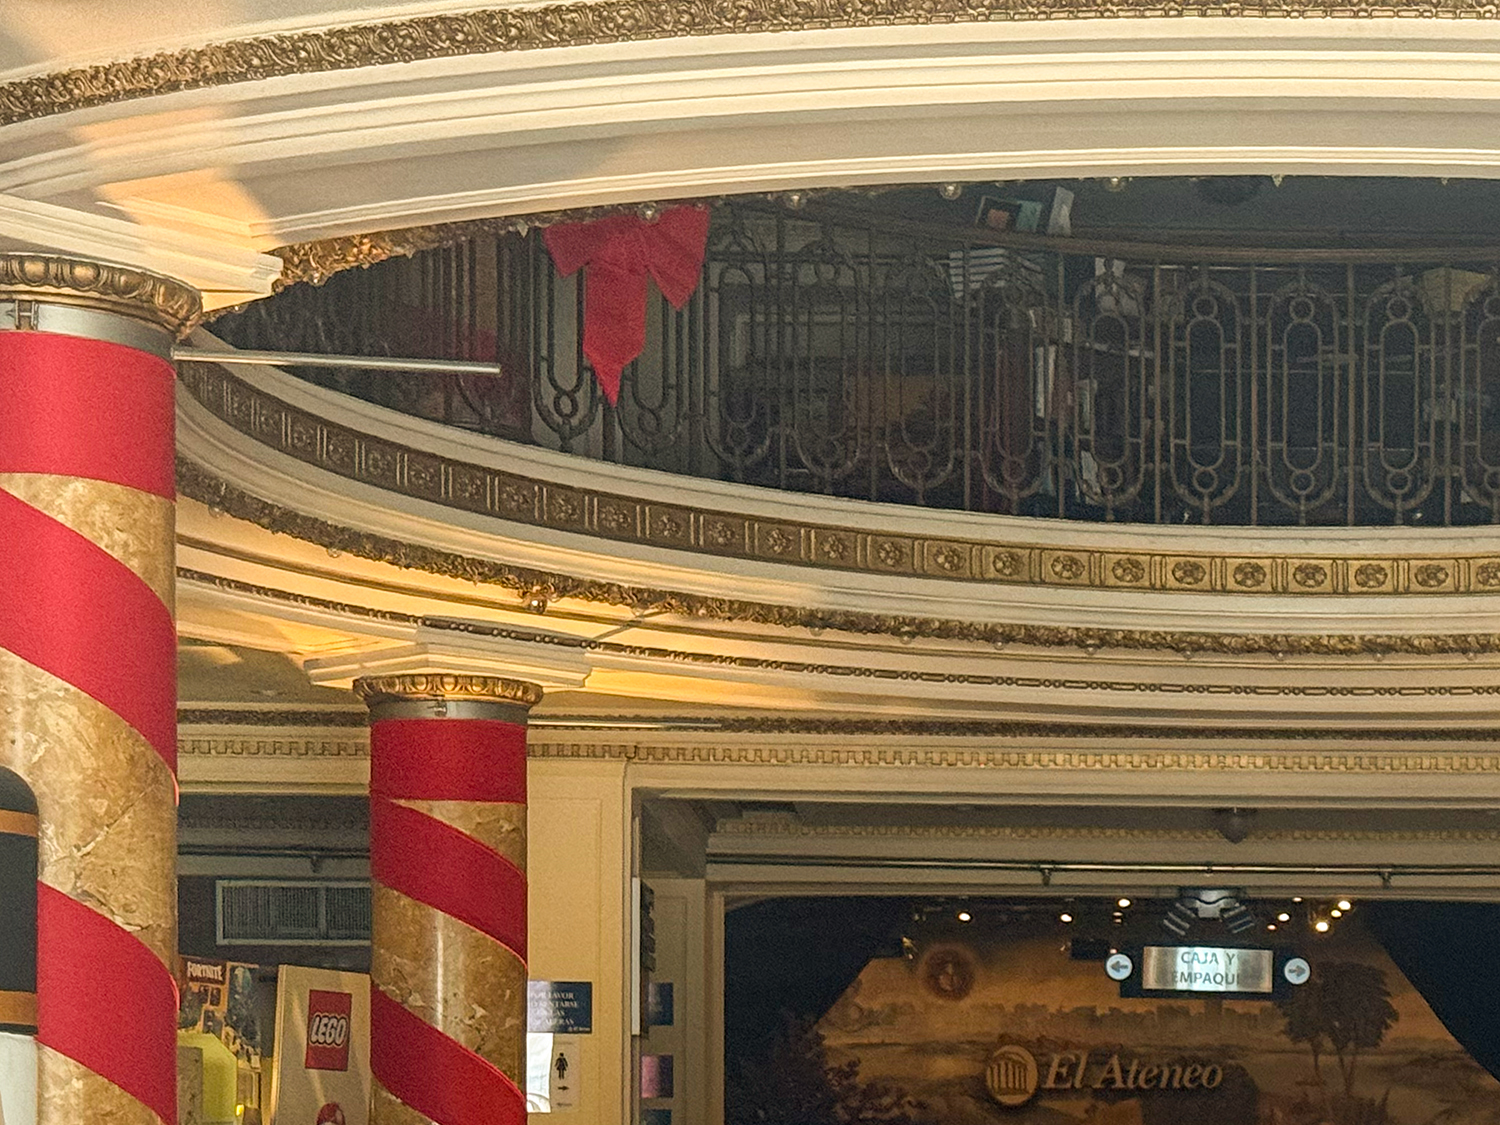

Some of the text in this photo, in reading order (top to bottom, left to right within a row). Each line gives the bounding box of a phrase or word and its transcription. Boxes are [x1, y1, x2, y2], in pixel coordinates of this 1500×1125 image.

[187, 961, 223, 981] FORTNITE
[1180, 951, 1236, 966] CAJA Y
[309, 1013, 349, 1047] LEGO
[1042, 1054, 1224, 1090] El Ateneo
